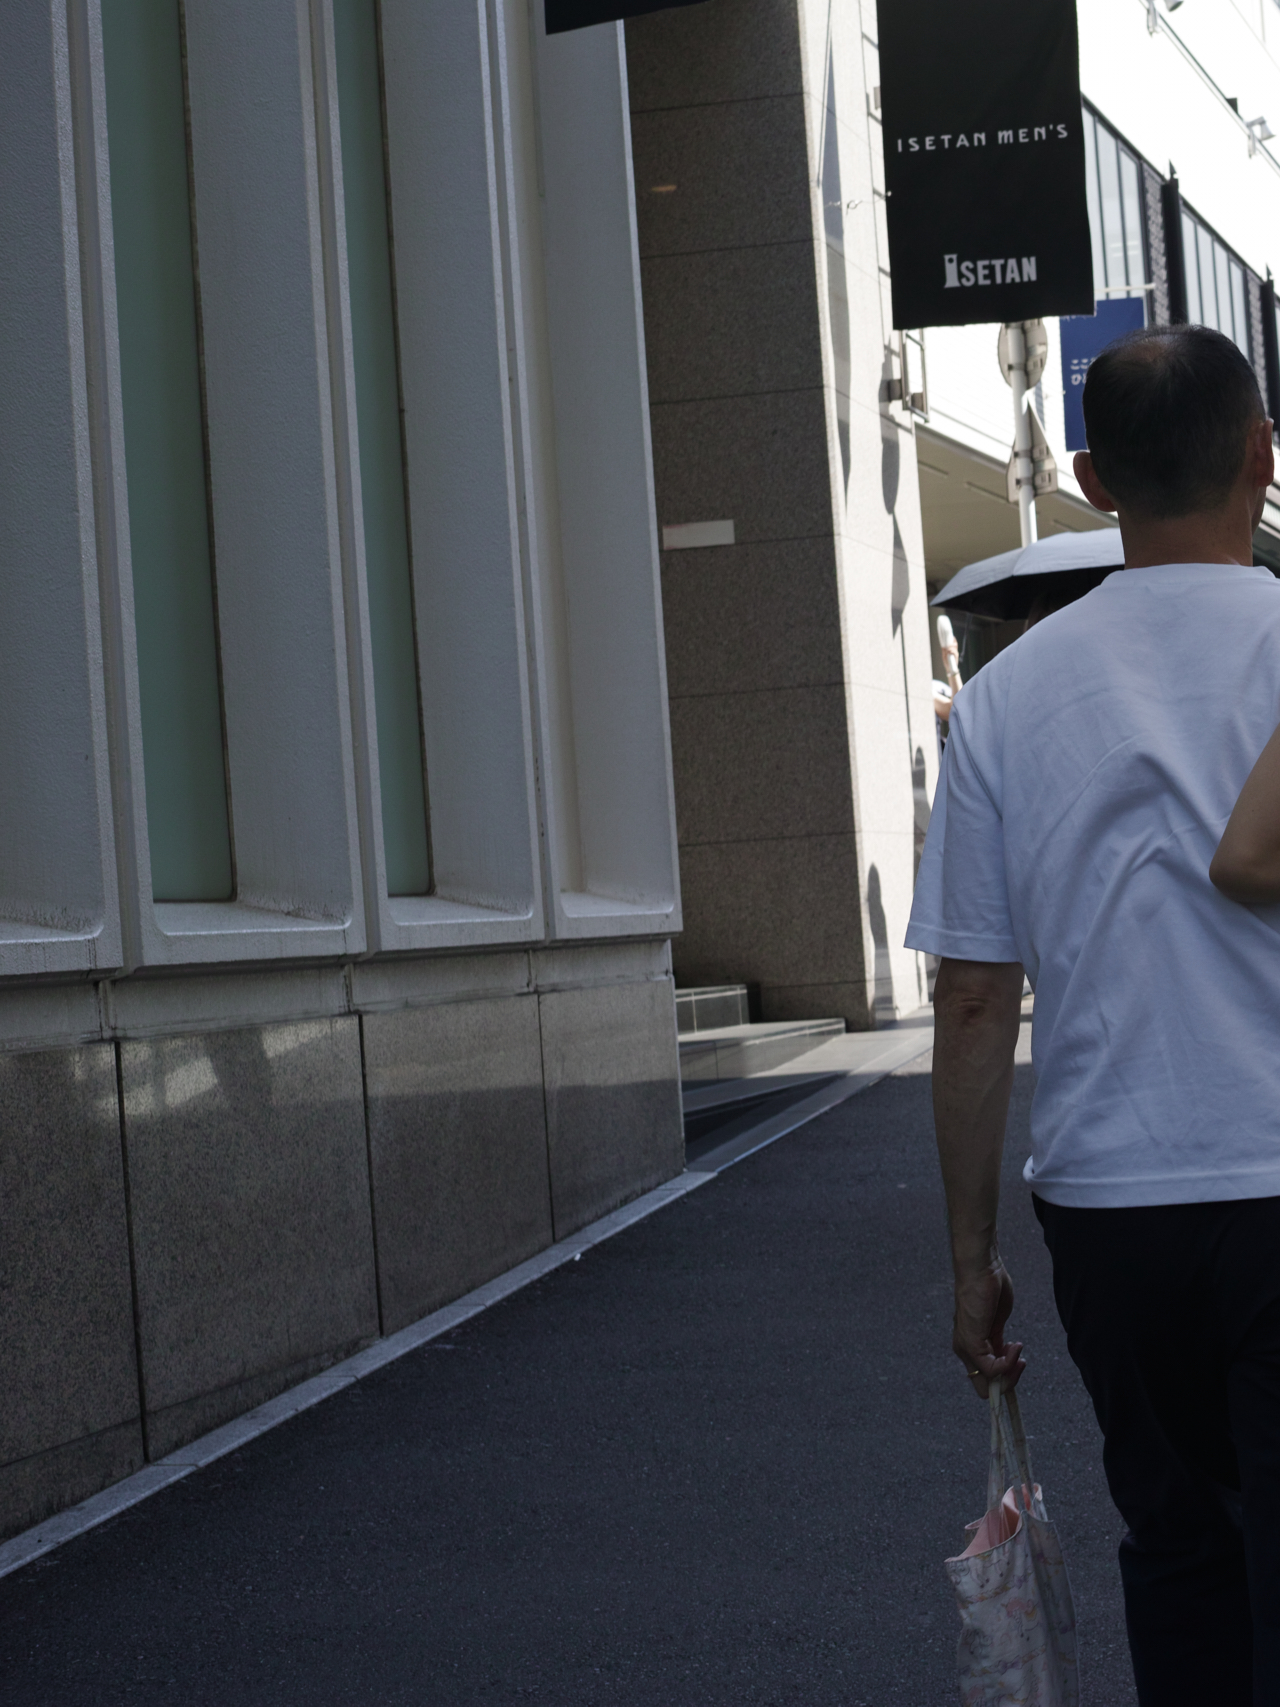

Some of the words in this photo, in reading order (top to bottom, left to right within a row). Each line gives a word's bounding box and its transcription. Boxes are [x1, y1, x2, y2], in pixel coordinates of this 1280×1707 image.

[897, 131, 986, 153] ISETAN
[997, 124, 1068, 145] MEN'S
[943, 253, 1037, 289] ISETAN
